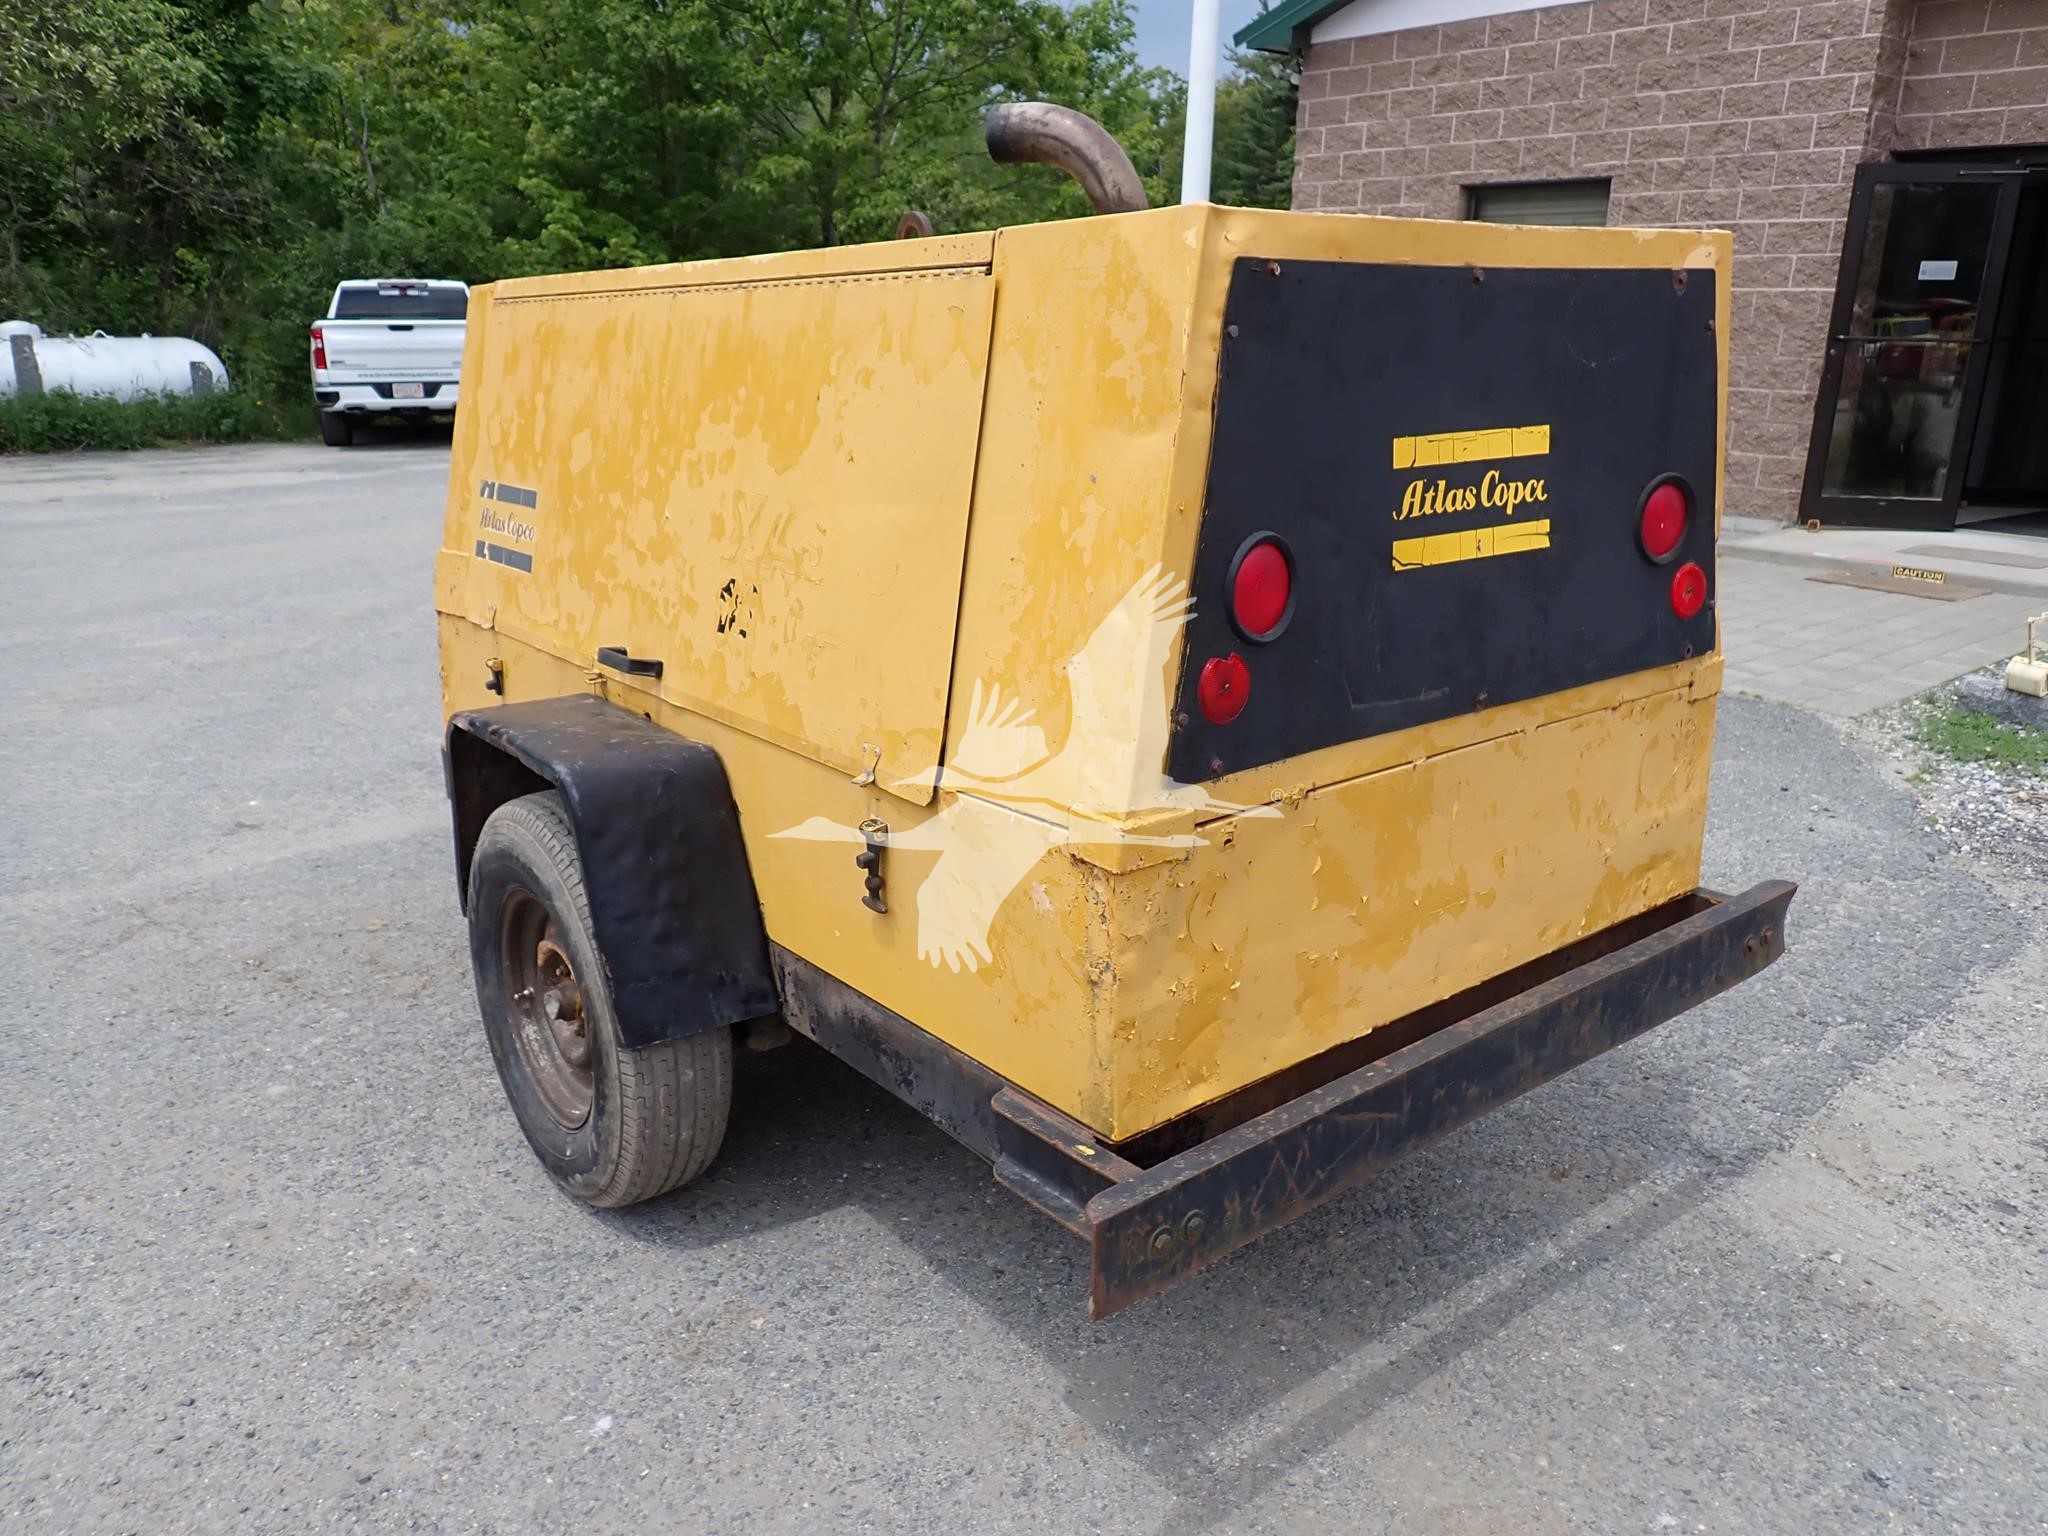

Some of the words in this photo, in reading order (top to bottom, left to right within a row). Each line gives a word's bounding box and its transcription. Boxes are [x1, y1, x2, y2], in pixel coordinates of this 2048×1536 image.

[1392, 479, 1476, 521] Atlas
[506, 511, 535, 544] Copco
[1896, 567, 1943, 580] CAUTION
